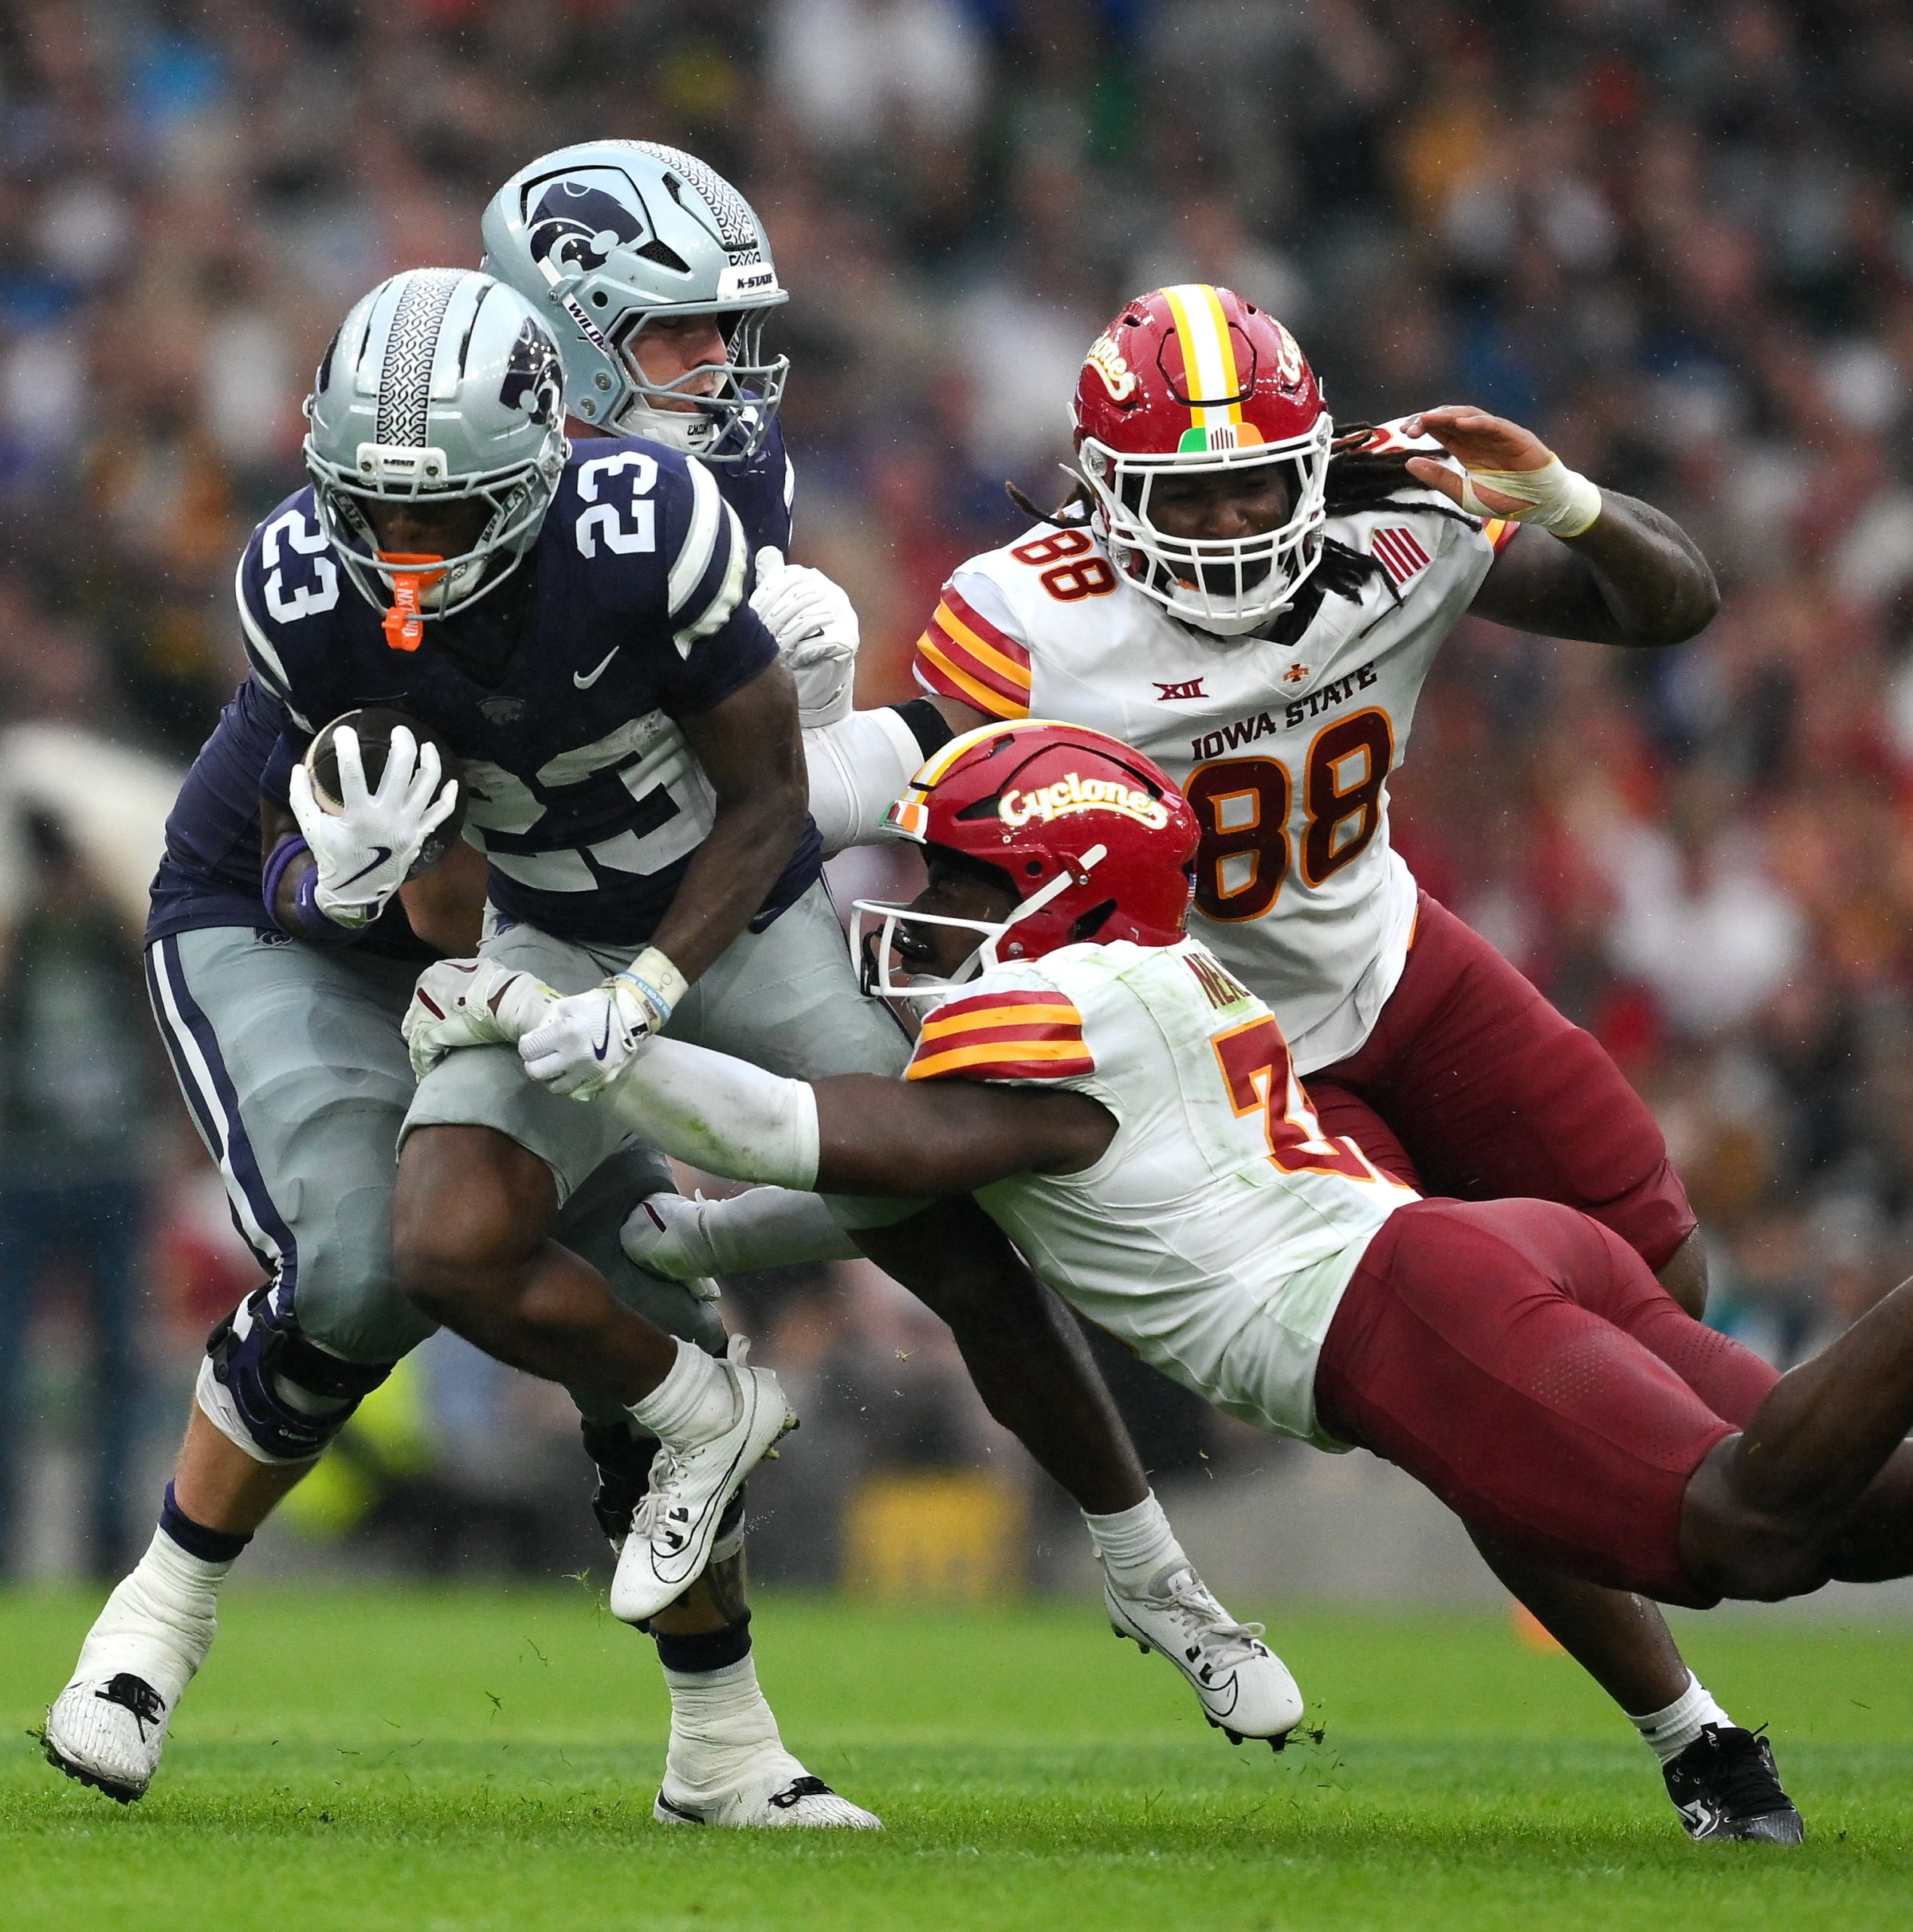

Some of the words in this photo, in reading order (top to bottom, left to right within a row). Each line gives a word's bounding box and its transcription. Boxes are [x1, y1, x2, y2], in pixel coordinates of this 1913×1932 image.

[737, 273, 773, 289] K-STATE
[576, 450, 658, 560] 23
[262, 508, 340, 625] 23
[1011, 528, 1118, 602] 88
[1192, 712, 1277, 762] IOWA
[1286, 660, 1377, 728] STATE
[462, 707, 717, 893] 23
[997, 772, 1169, 831] Cyclones
[1182, 706, 1393, 923] 88
